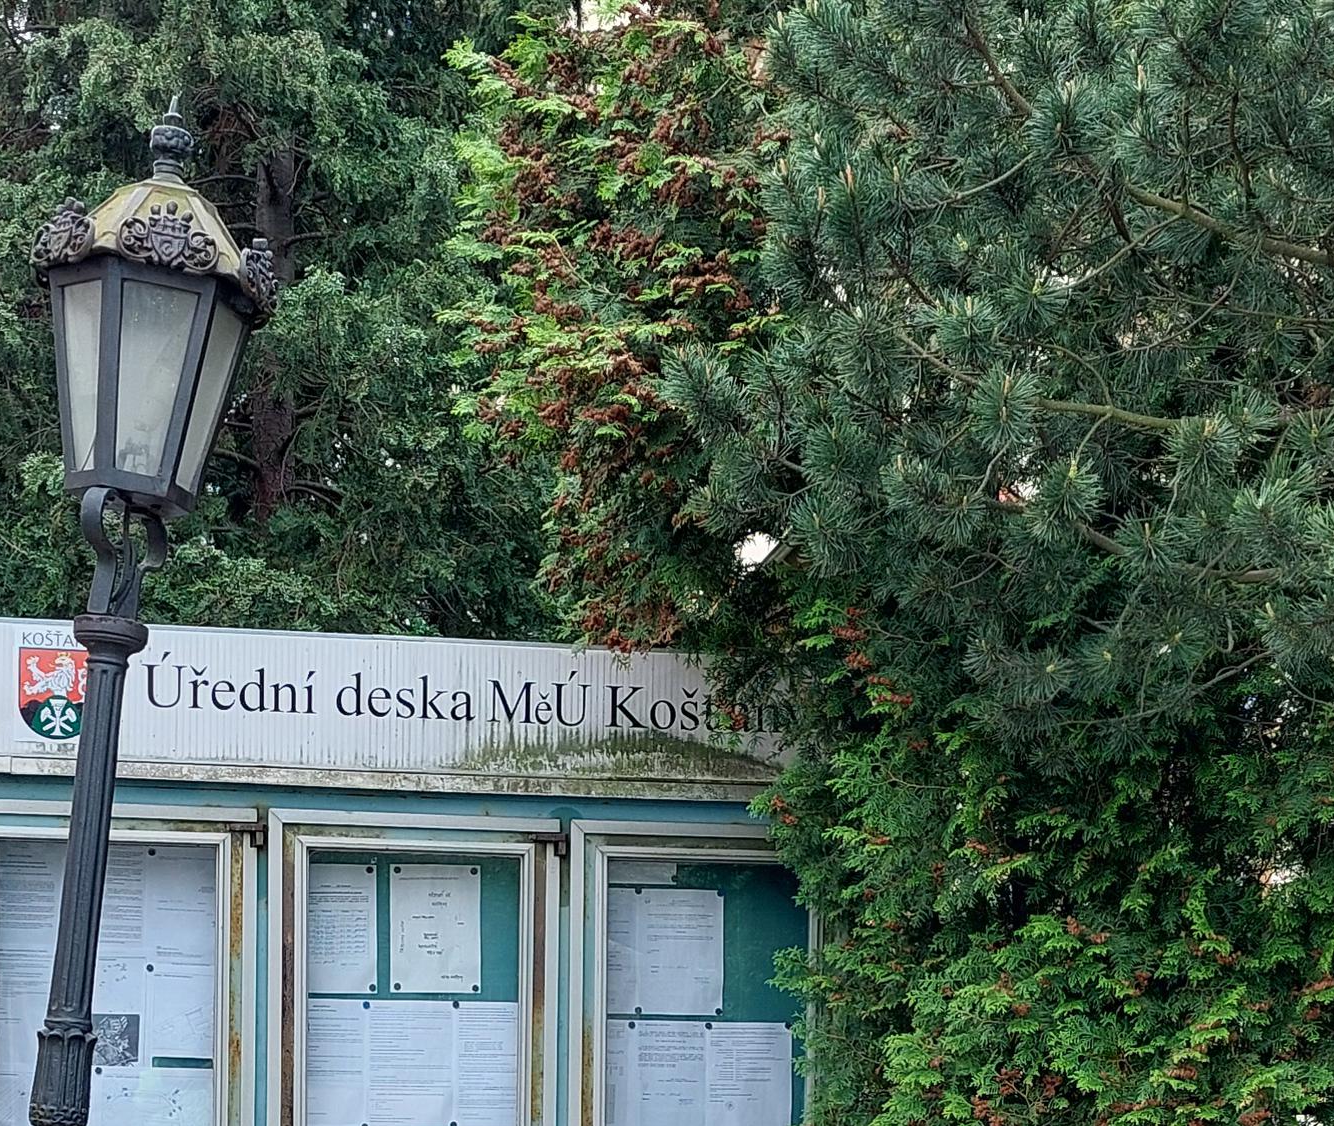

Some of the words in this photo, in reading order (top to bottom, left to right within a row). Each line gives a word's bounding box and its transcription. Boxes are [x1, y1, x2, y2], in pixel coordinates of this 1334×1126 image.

[141, 651, 317, 715] Úřední
[335, 672, 477, 722] deska
[487, 670, 592, 728] MěÚ
